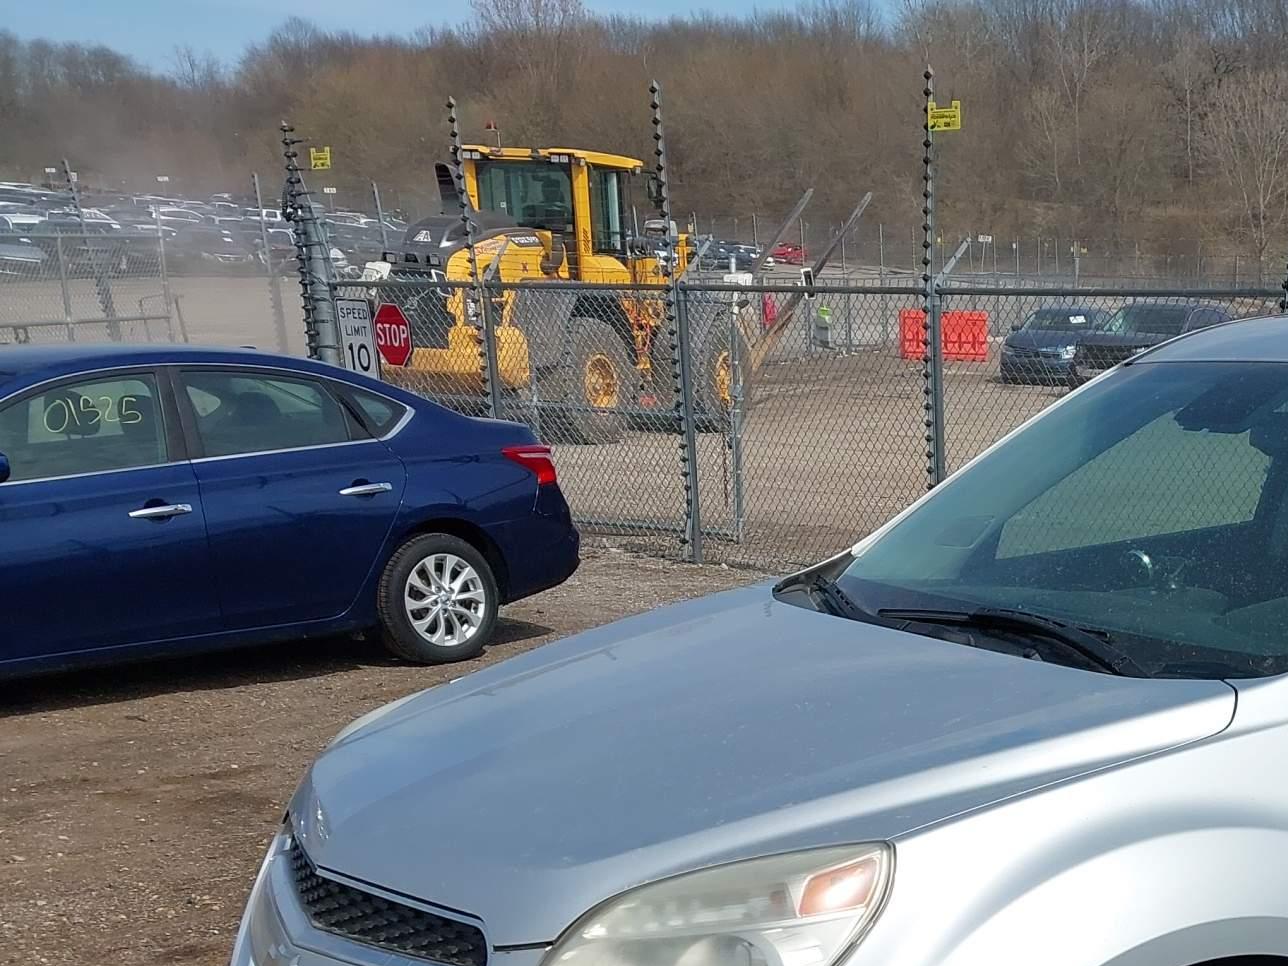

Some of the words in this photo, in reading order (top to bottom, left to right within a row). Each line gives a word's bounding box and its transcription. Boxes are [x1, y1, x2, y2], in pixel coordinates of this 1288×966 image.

[340, 307, 368, 320] SPEED
[344, 325, 367, 337] LIMIT
[376, 322, 408, 347] STOP
[348, 342, 371, 372] 10
